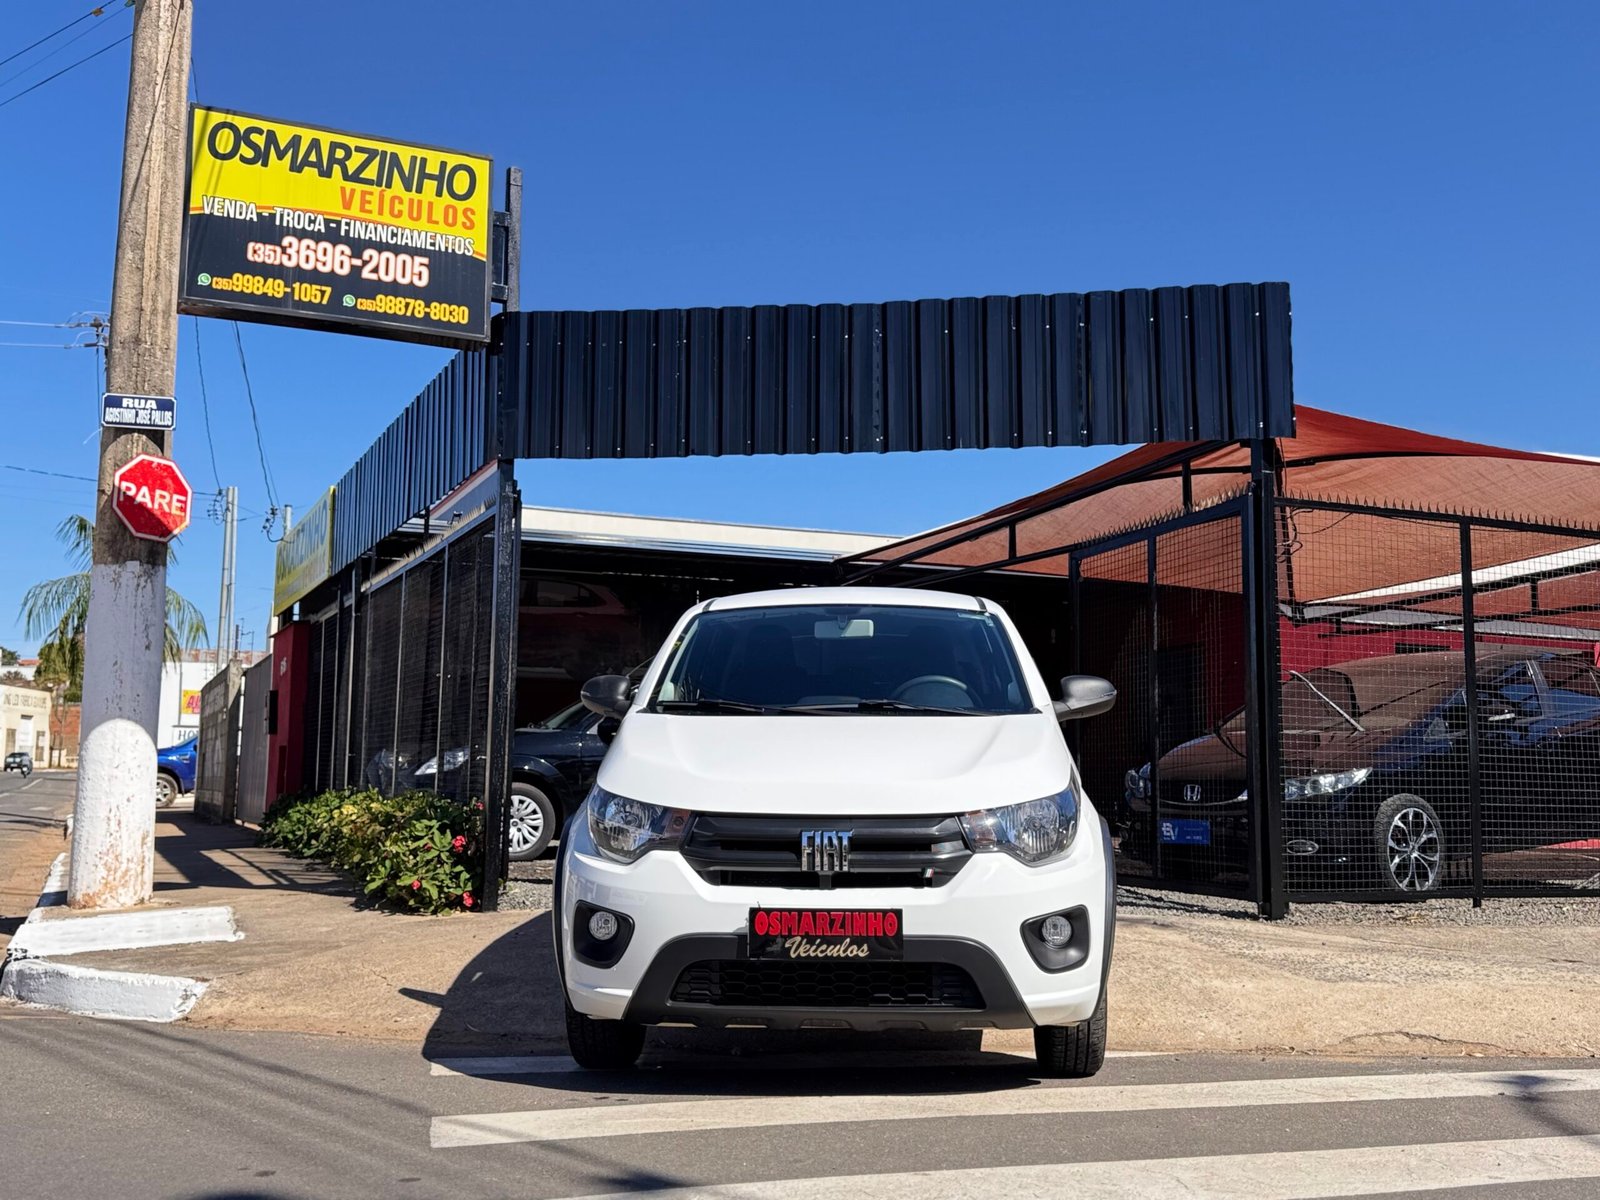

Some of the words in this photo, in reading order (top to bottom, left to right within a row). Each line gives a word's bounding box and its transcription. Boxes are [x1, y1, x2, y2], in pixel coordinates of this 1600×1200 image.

[207, 121, 477, 201] OSMARZINHO
[202, 195, 258, 222] VENDA
[273, 207, 326, 233] TROCA
[340, 218, 475, 257] FINANCIAMENTOS
[339, 186, 477, 230] VEÍCULOS
[121, 397, 158, 410] RUA
[119, 480, 187, 517] PARE
[801, 830, 854, 872] FIAT
[754, 910, 898, 937] OSMARZINHO
